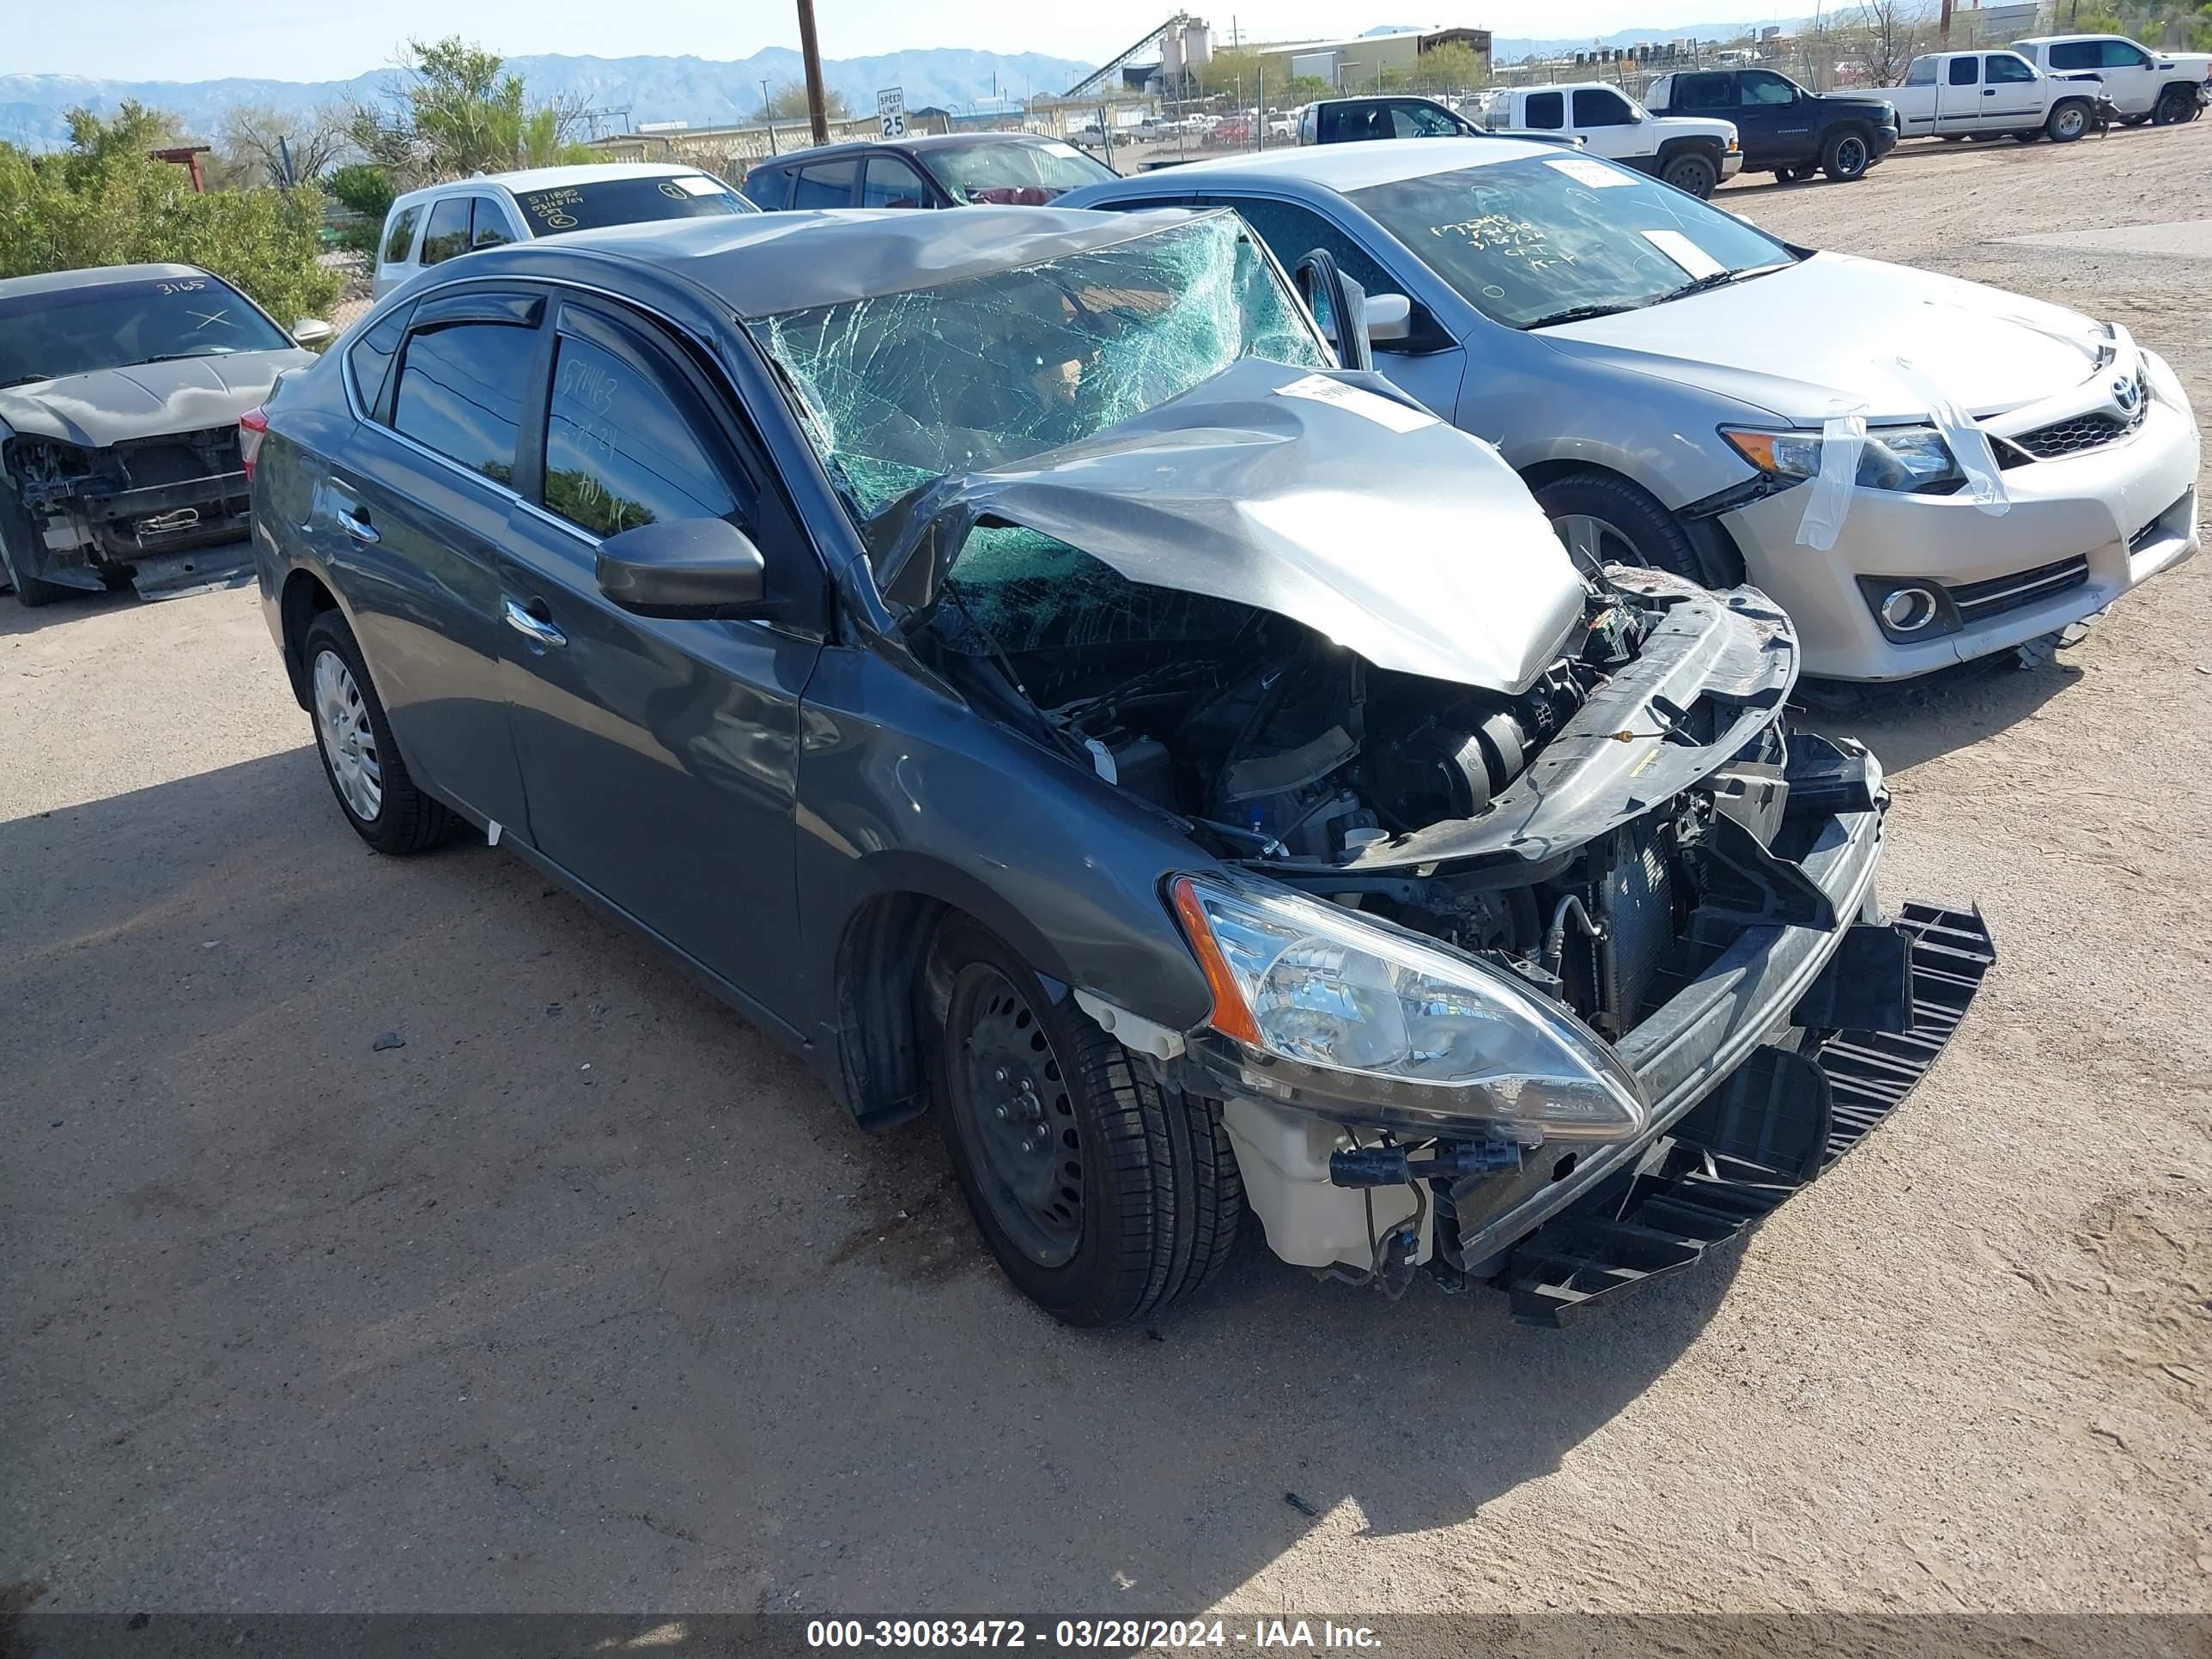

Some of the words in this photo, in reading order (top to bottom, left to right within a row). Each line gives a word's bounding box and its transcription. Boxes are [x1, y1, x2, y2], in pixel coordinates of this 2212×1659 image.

[880, 94, 902, 105] SPEED
[883, 104, 901, 116] LIMIT
[883, 116, 904, 137] 25
[156, 280, 205, 295] 3165
